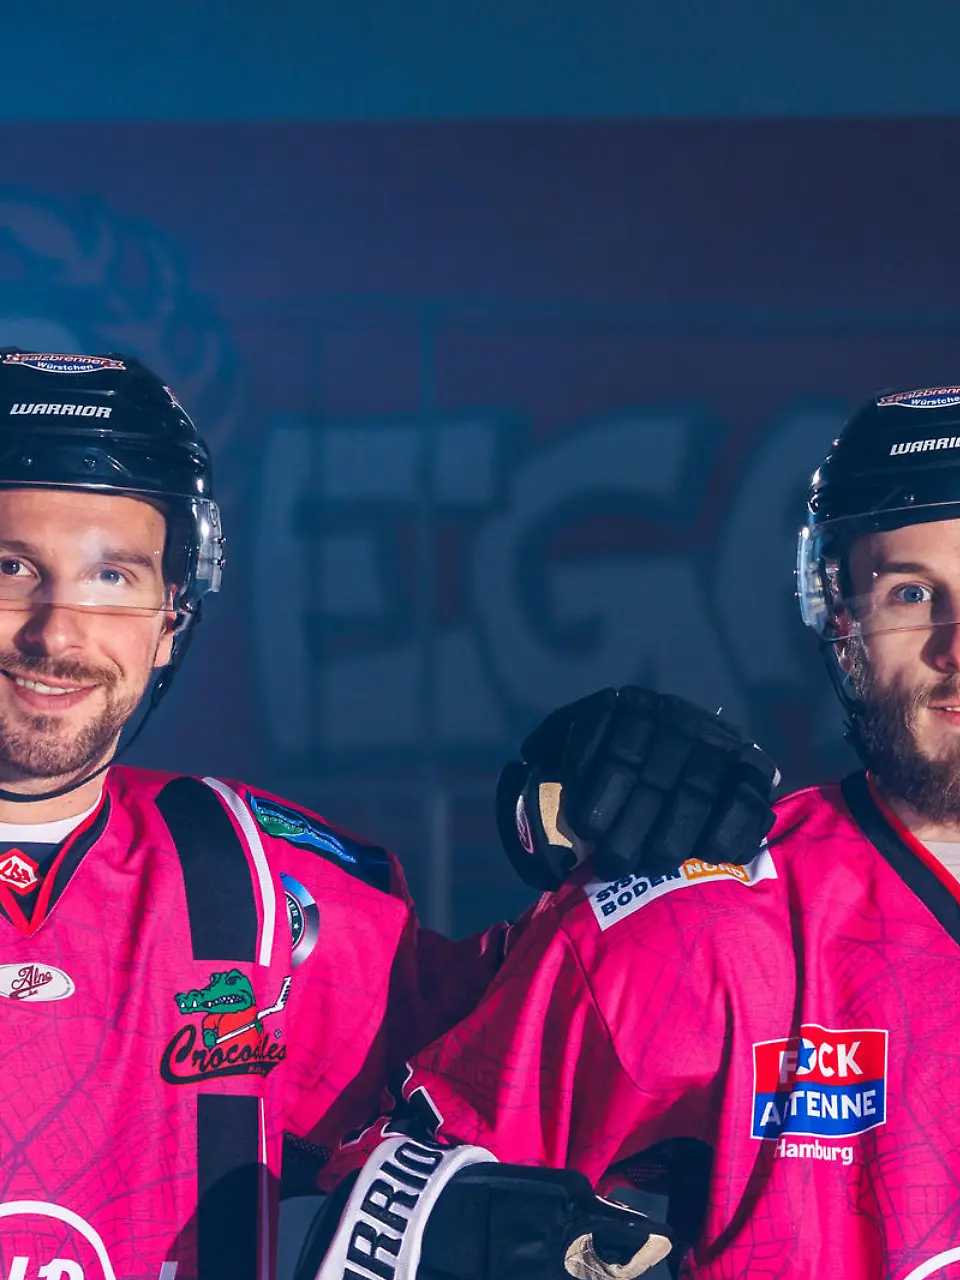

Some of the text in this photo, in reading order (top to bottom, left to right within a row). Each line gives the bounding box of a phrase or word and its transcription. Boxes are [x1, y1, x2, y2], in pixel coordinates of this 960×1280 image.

[37, 360, 94, 371] Würstchen
[10, 403, 113, 418] WARRIOR
[601, 867, 682, 917] BODEN
